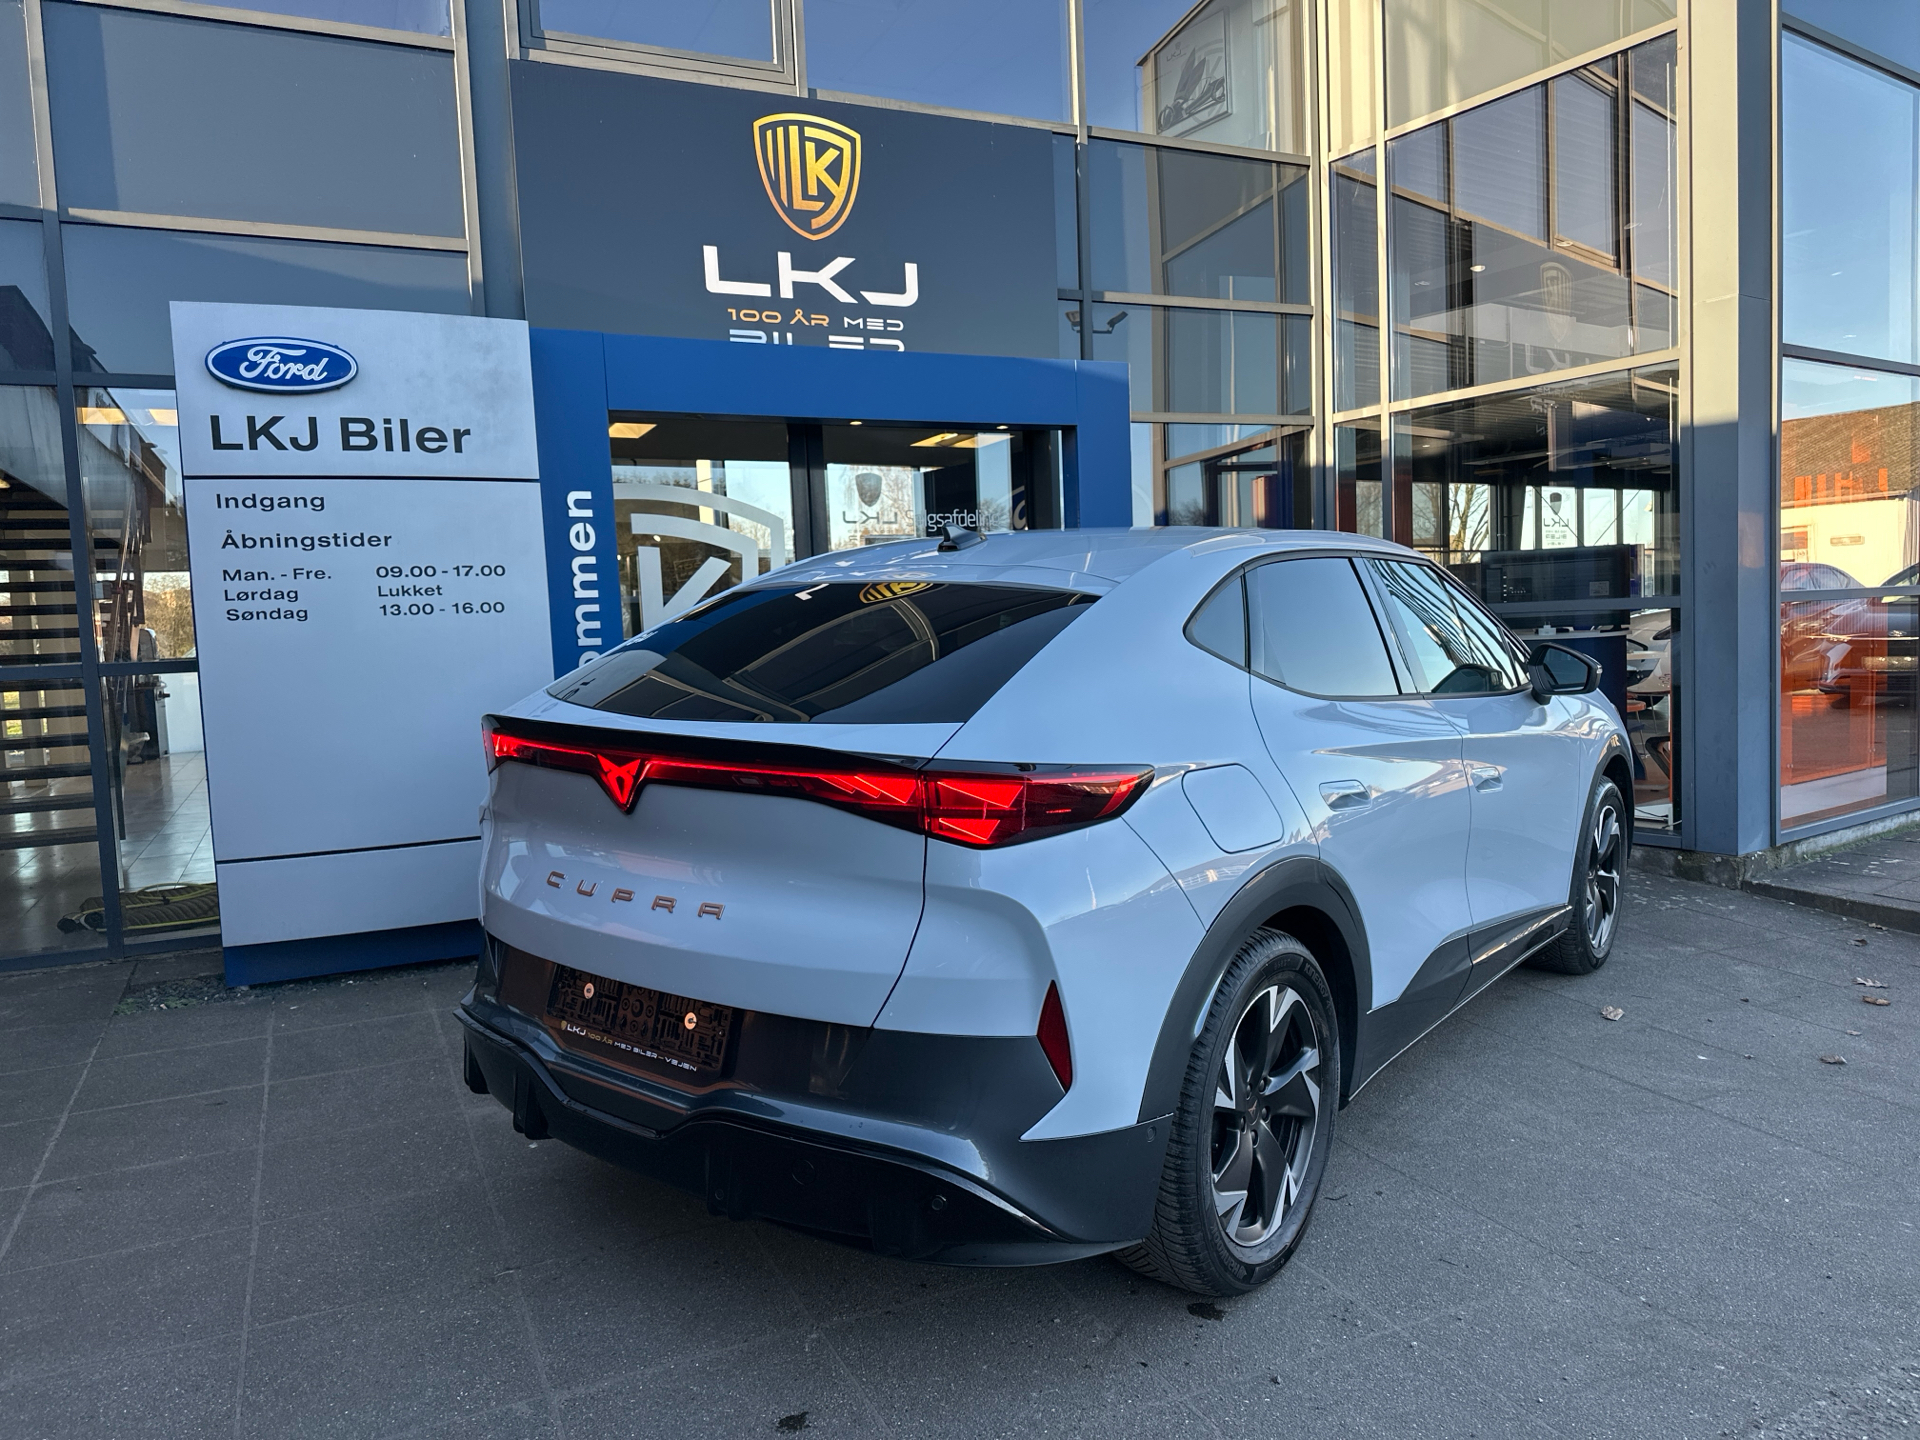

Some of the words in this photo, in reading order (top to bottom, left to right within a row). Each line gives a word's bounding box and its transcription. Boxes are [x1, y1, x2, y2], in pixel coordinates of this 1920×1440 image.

[703, 245, 919, 307] LKJ
[727, 308, 782, 324] 100
[790, 309, 829, 326] ÅR
[844, 316, 904, 331] MED
[238, 345, 328, 382] Ford
[210, 415, 319, 451] LKJ
[340, 417, 471, 453] Biler
[216, 493, 326, 512] Indgang
[221, 529, 393, 551] Åbningstider
[222, 568, 275, 581] Man.
[293, 566, 332, 580] Fre.
[375, 565, 436, 578] 09.00
[452, 564, 506, 578] 17.00
[224, 588, 299, 602] Lørdag
[378, 584, 443, 597] Lukket
[226, 608, 308, 622] Søndag
[379, 603, 434, 616] 13.00
[452, 601, 506, 615] 16.00
[546, 870, 726, 920] CUPRA
[566, 1023, 587, 1036] LKJ
[587, 1032, 601, 1041] 100
[613, 1041, 632, 1051] MED
